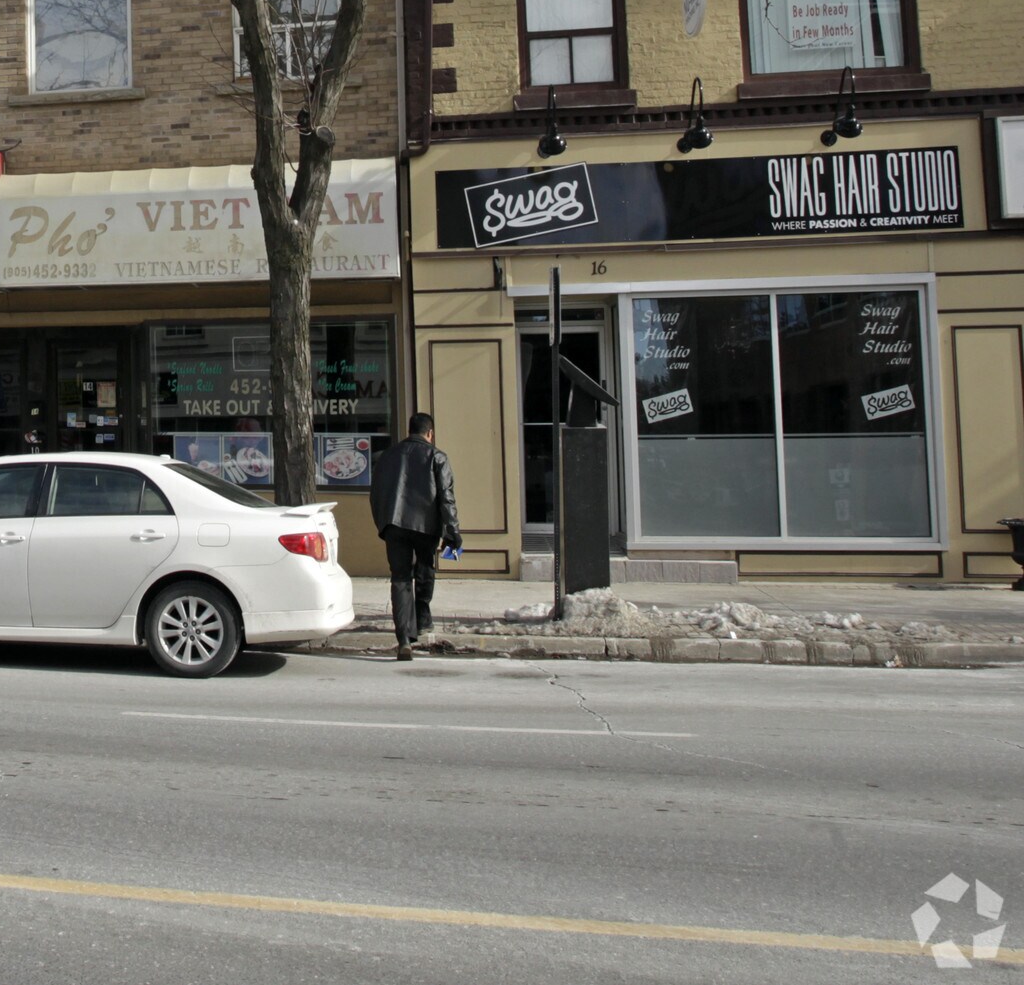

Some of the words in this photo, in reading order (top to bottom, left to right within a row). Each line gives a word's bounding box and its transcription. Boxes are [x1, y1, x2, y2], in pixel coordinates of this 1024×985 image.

[792, 5, 803, 17] Be
[806, 4, 820, 17] Job
[823, 2, 848, 18] Ready
[792, 26, 800, 38] in
[803, 26, 819, 38] Few
[822, 23, 854, 37] Months
[767, 156, 827, 218] SWAG
[832, 153, 881, 216] HAIR
[886, 149, 958, 213] STUDIO
[771, 221, 806, 231] WHERE
[809, 218, 857, 230] PASSION
[860, 217, 868, 227] &
[869, 215, 930, 226] CREATIVITY
[932, 214, 959, 224] MEET
[115, 258, 241, 278] VIETNAMESE
[256, 253, 390, 275] RAURANT
[591, 260, 607, 276] 16
[641, 309, 680, 325] Swag
[861, 303, 901, 319] Swag
[640, 327, 678, 341] Hair
[859, 322, 899, 335] Hair
[643, 345, 691, 359] Studio
[862, 340, 912, 354] Studio
[666, 362, 690, 370] .com
[886, 357, 911, 365] .com
[83, 381, 94, 392] 14
[183, 399, 221, 415] TAKE
[226, 399, 261, 416] OUT
[312, 398, 359, 415] IVERY
